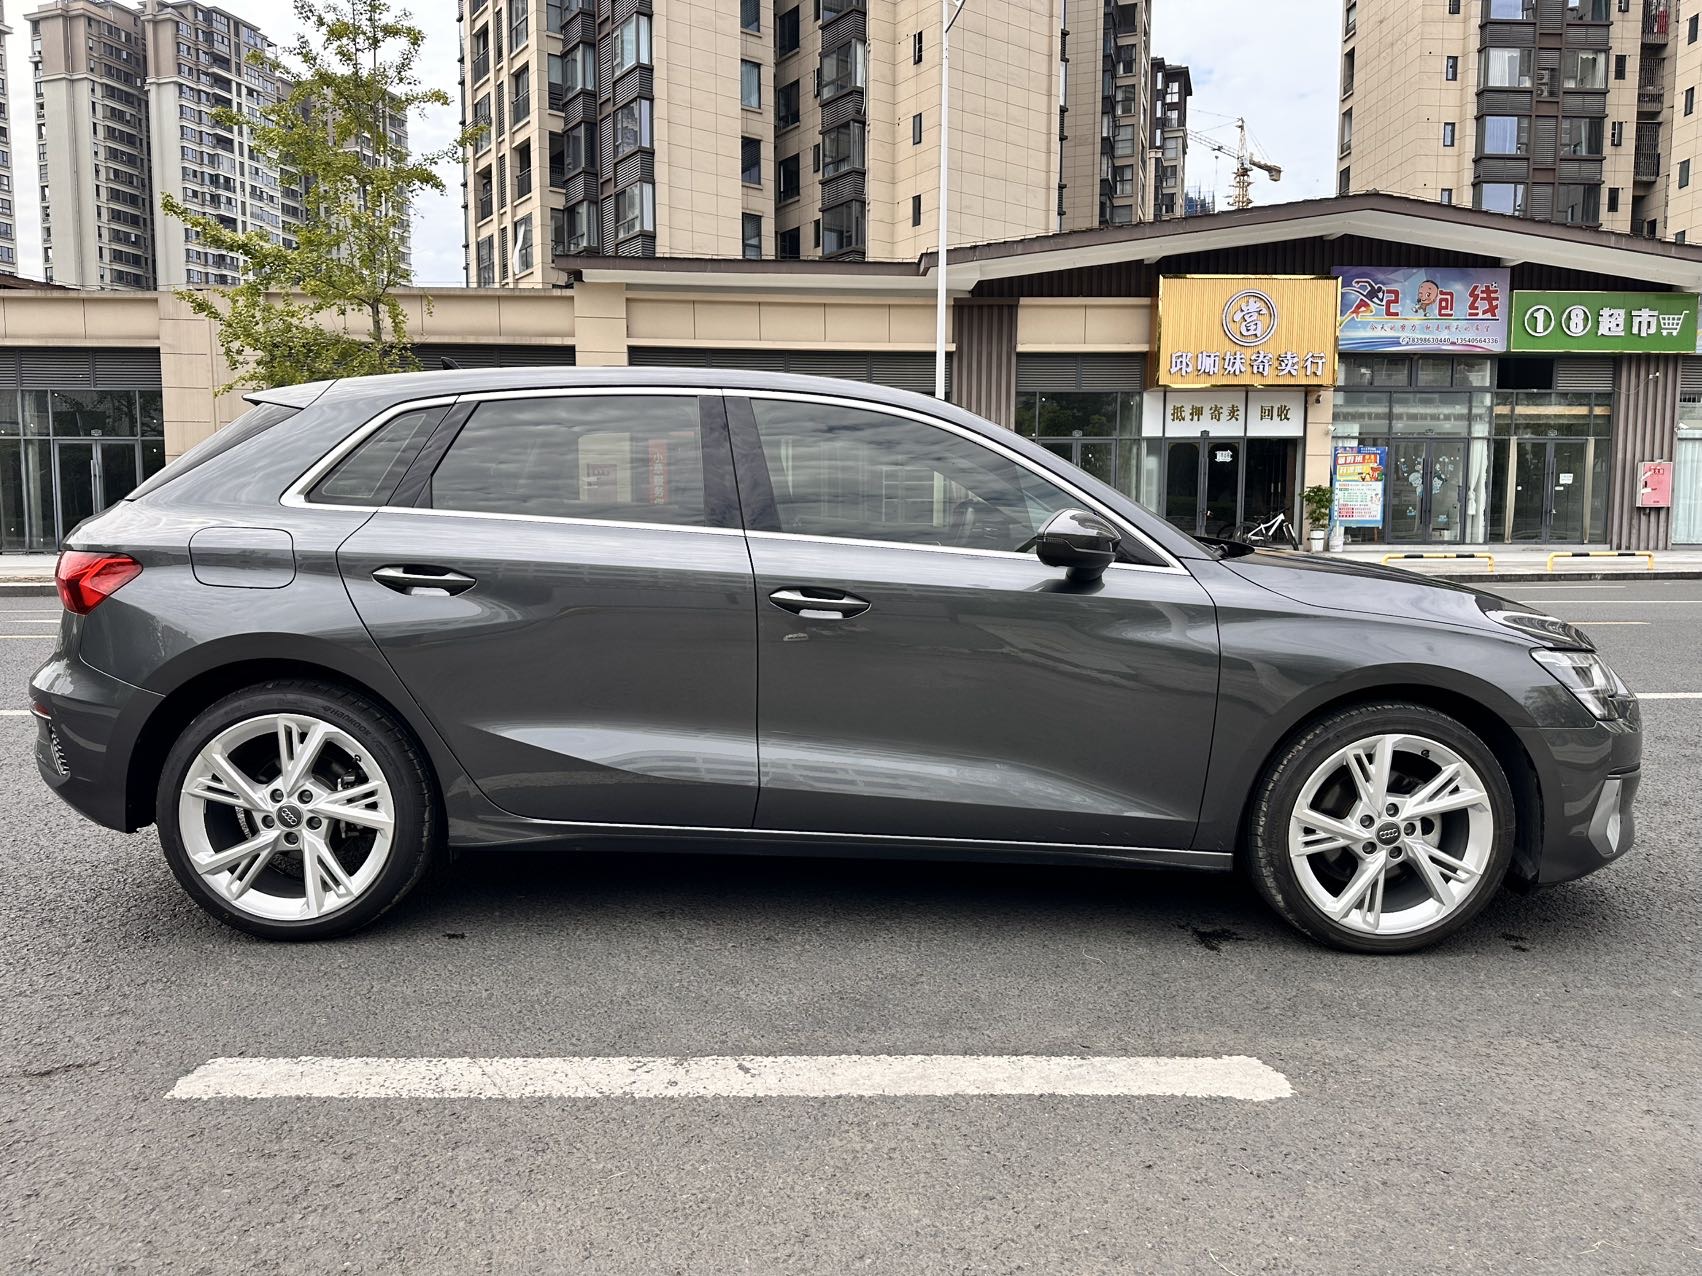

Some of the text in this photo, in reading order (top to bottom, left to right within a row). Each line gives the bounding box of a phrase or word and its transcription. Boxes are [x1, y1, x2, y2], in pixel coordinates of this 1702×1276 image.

[1232, 299, 1268, 338] 當
[1169, 350, 1327, 377] 邱师妹寄卖行
[1260, 405, 1291, 422] 回收
